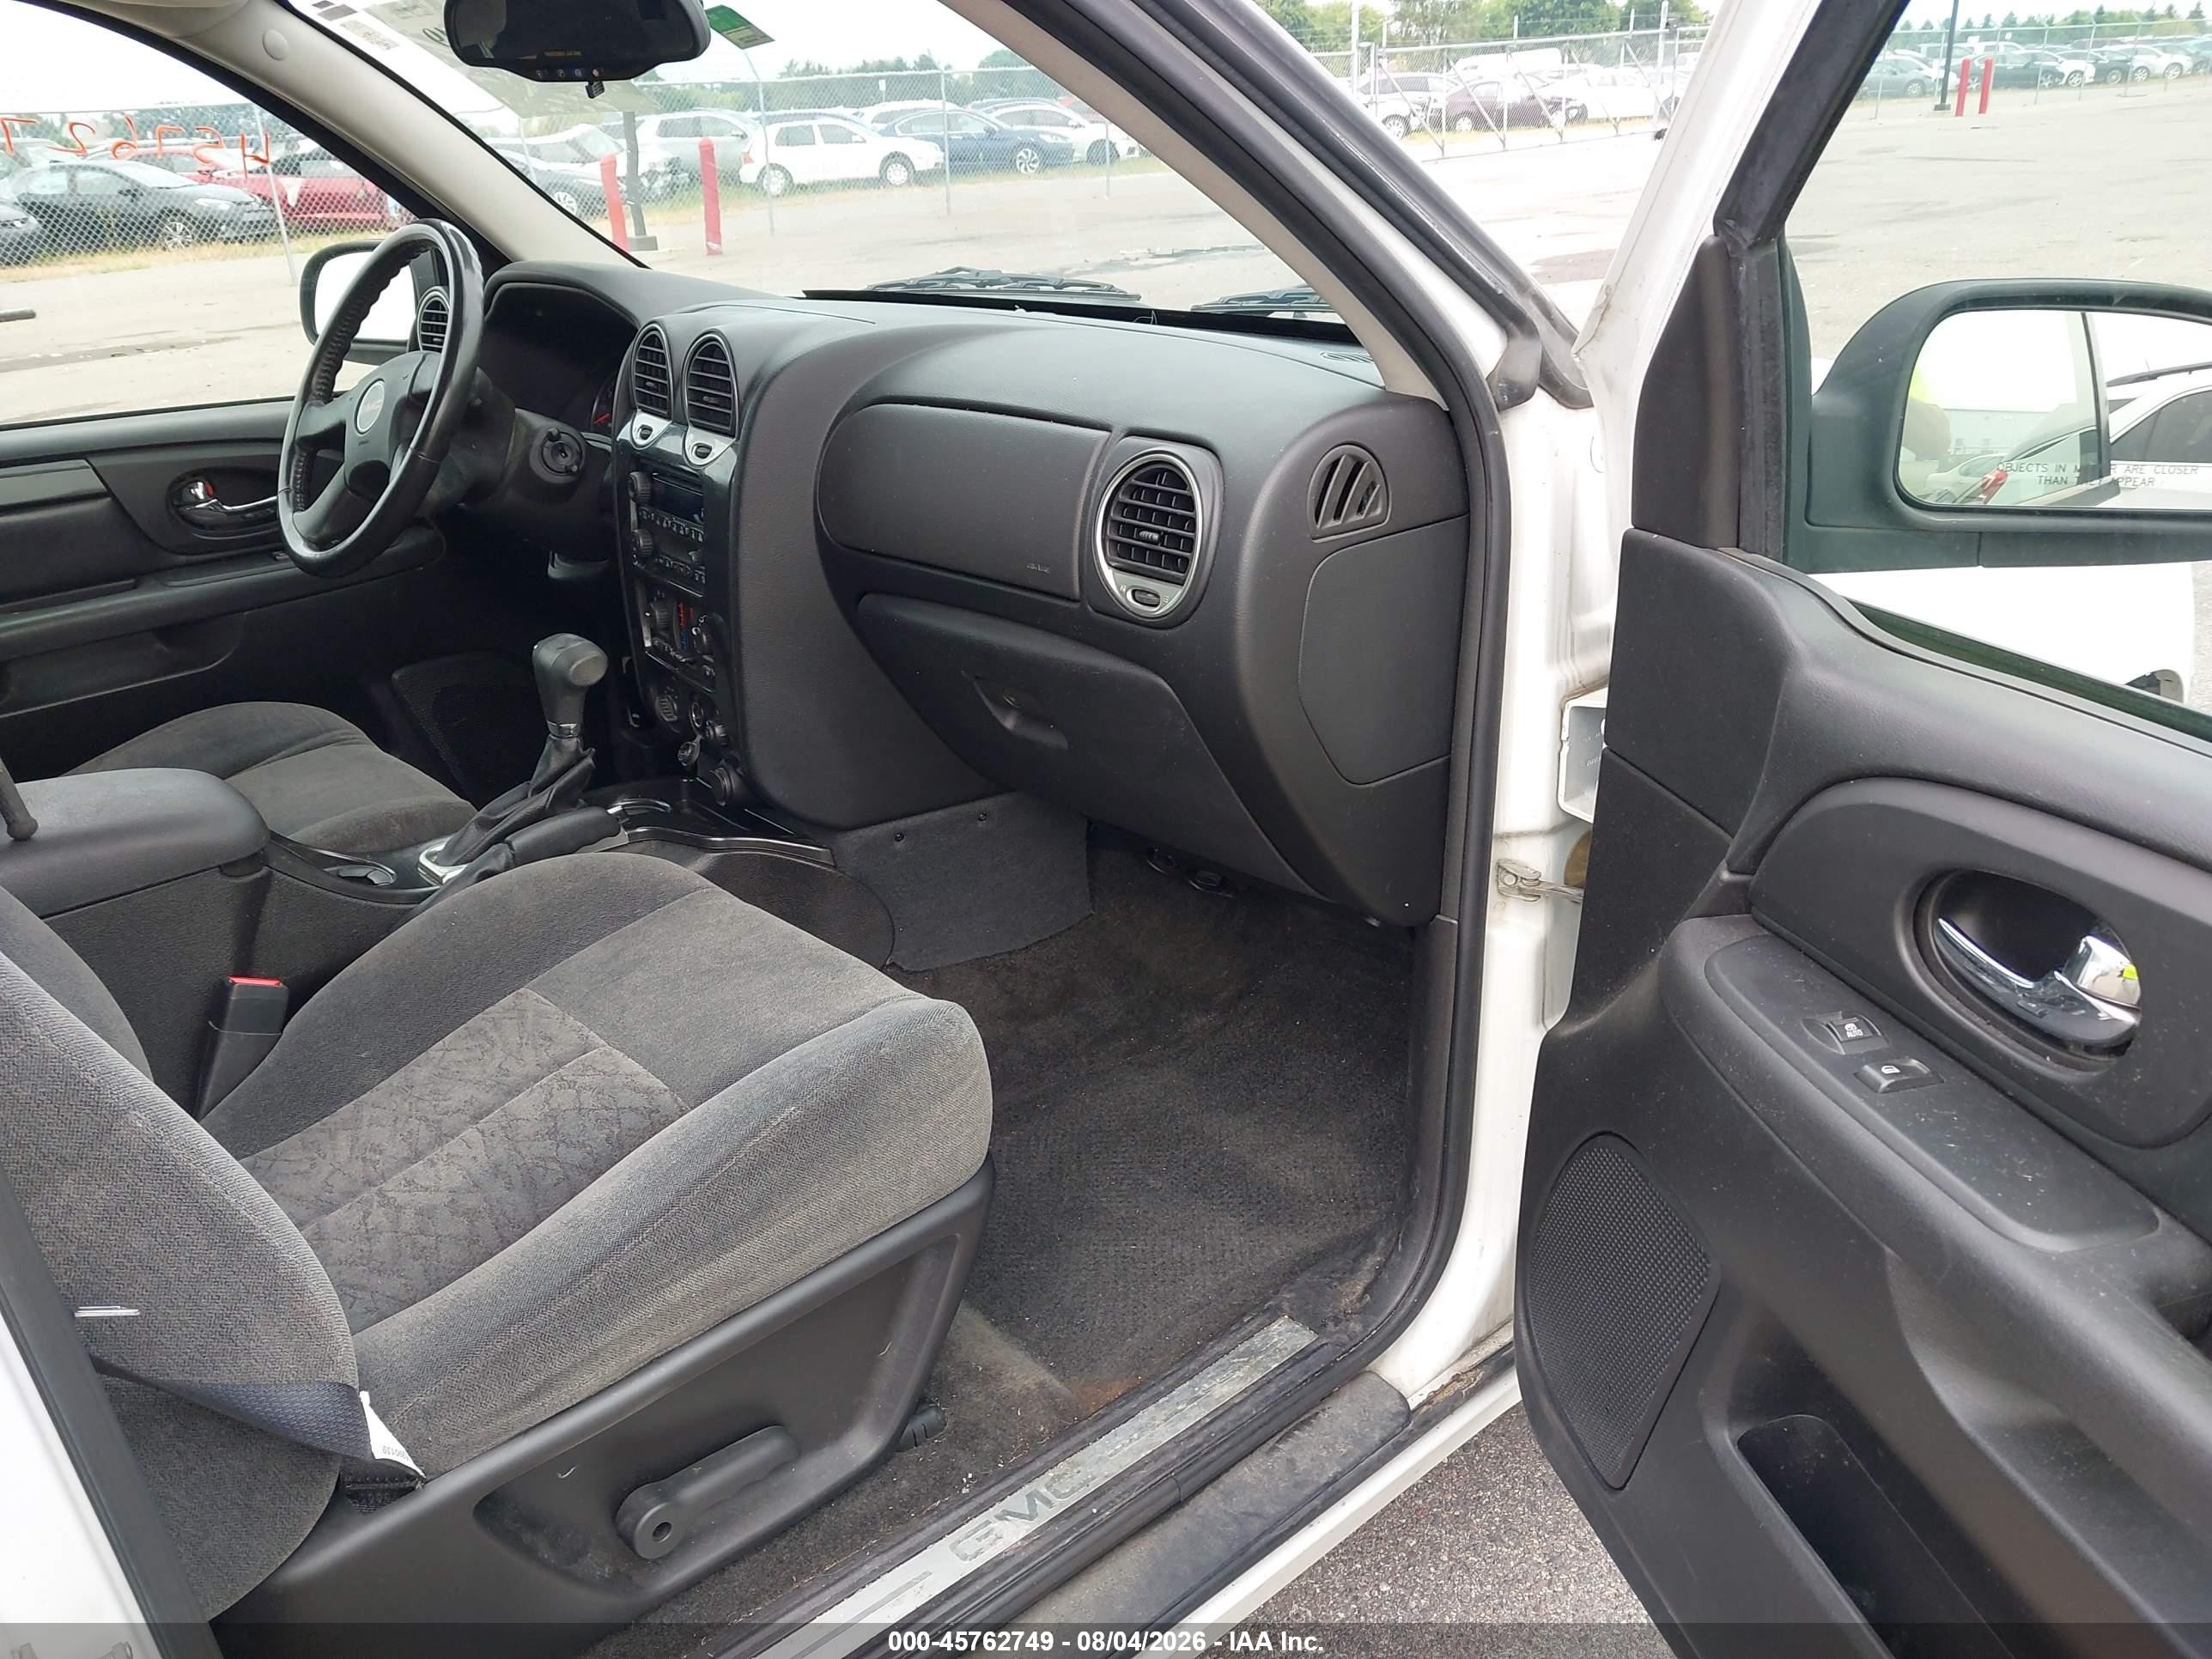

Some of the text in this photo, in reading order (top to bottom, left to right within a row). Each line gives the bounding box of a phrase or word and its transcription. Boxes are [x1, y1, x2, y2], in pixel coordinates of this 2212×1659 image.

[1996, 462, 2048, 473] OBJECTS
[2054, 464, 2067, 473] IN
[2124, 465, 2145, 474] ARE
[2154, 465, 2198, 475] CLOSER
[2038, 475, 2069, 486] THAN
[1846, 1029, 1863, 1038] AUTO
[949, 1462, 1097, 1562] GMC
